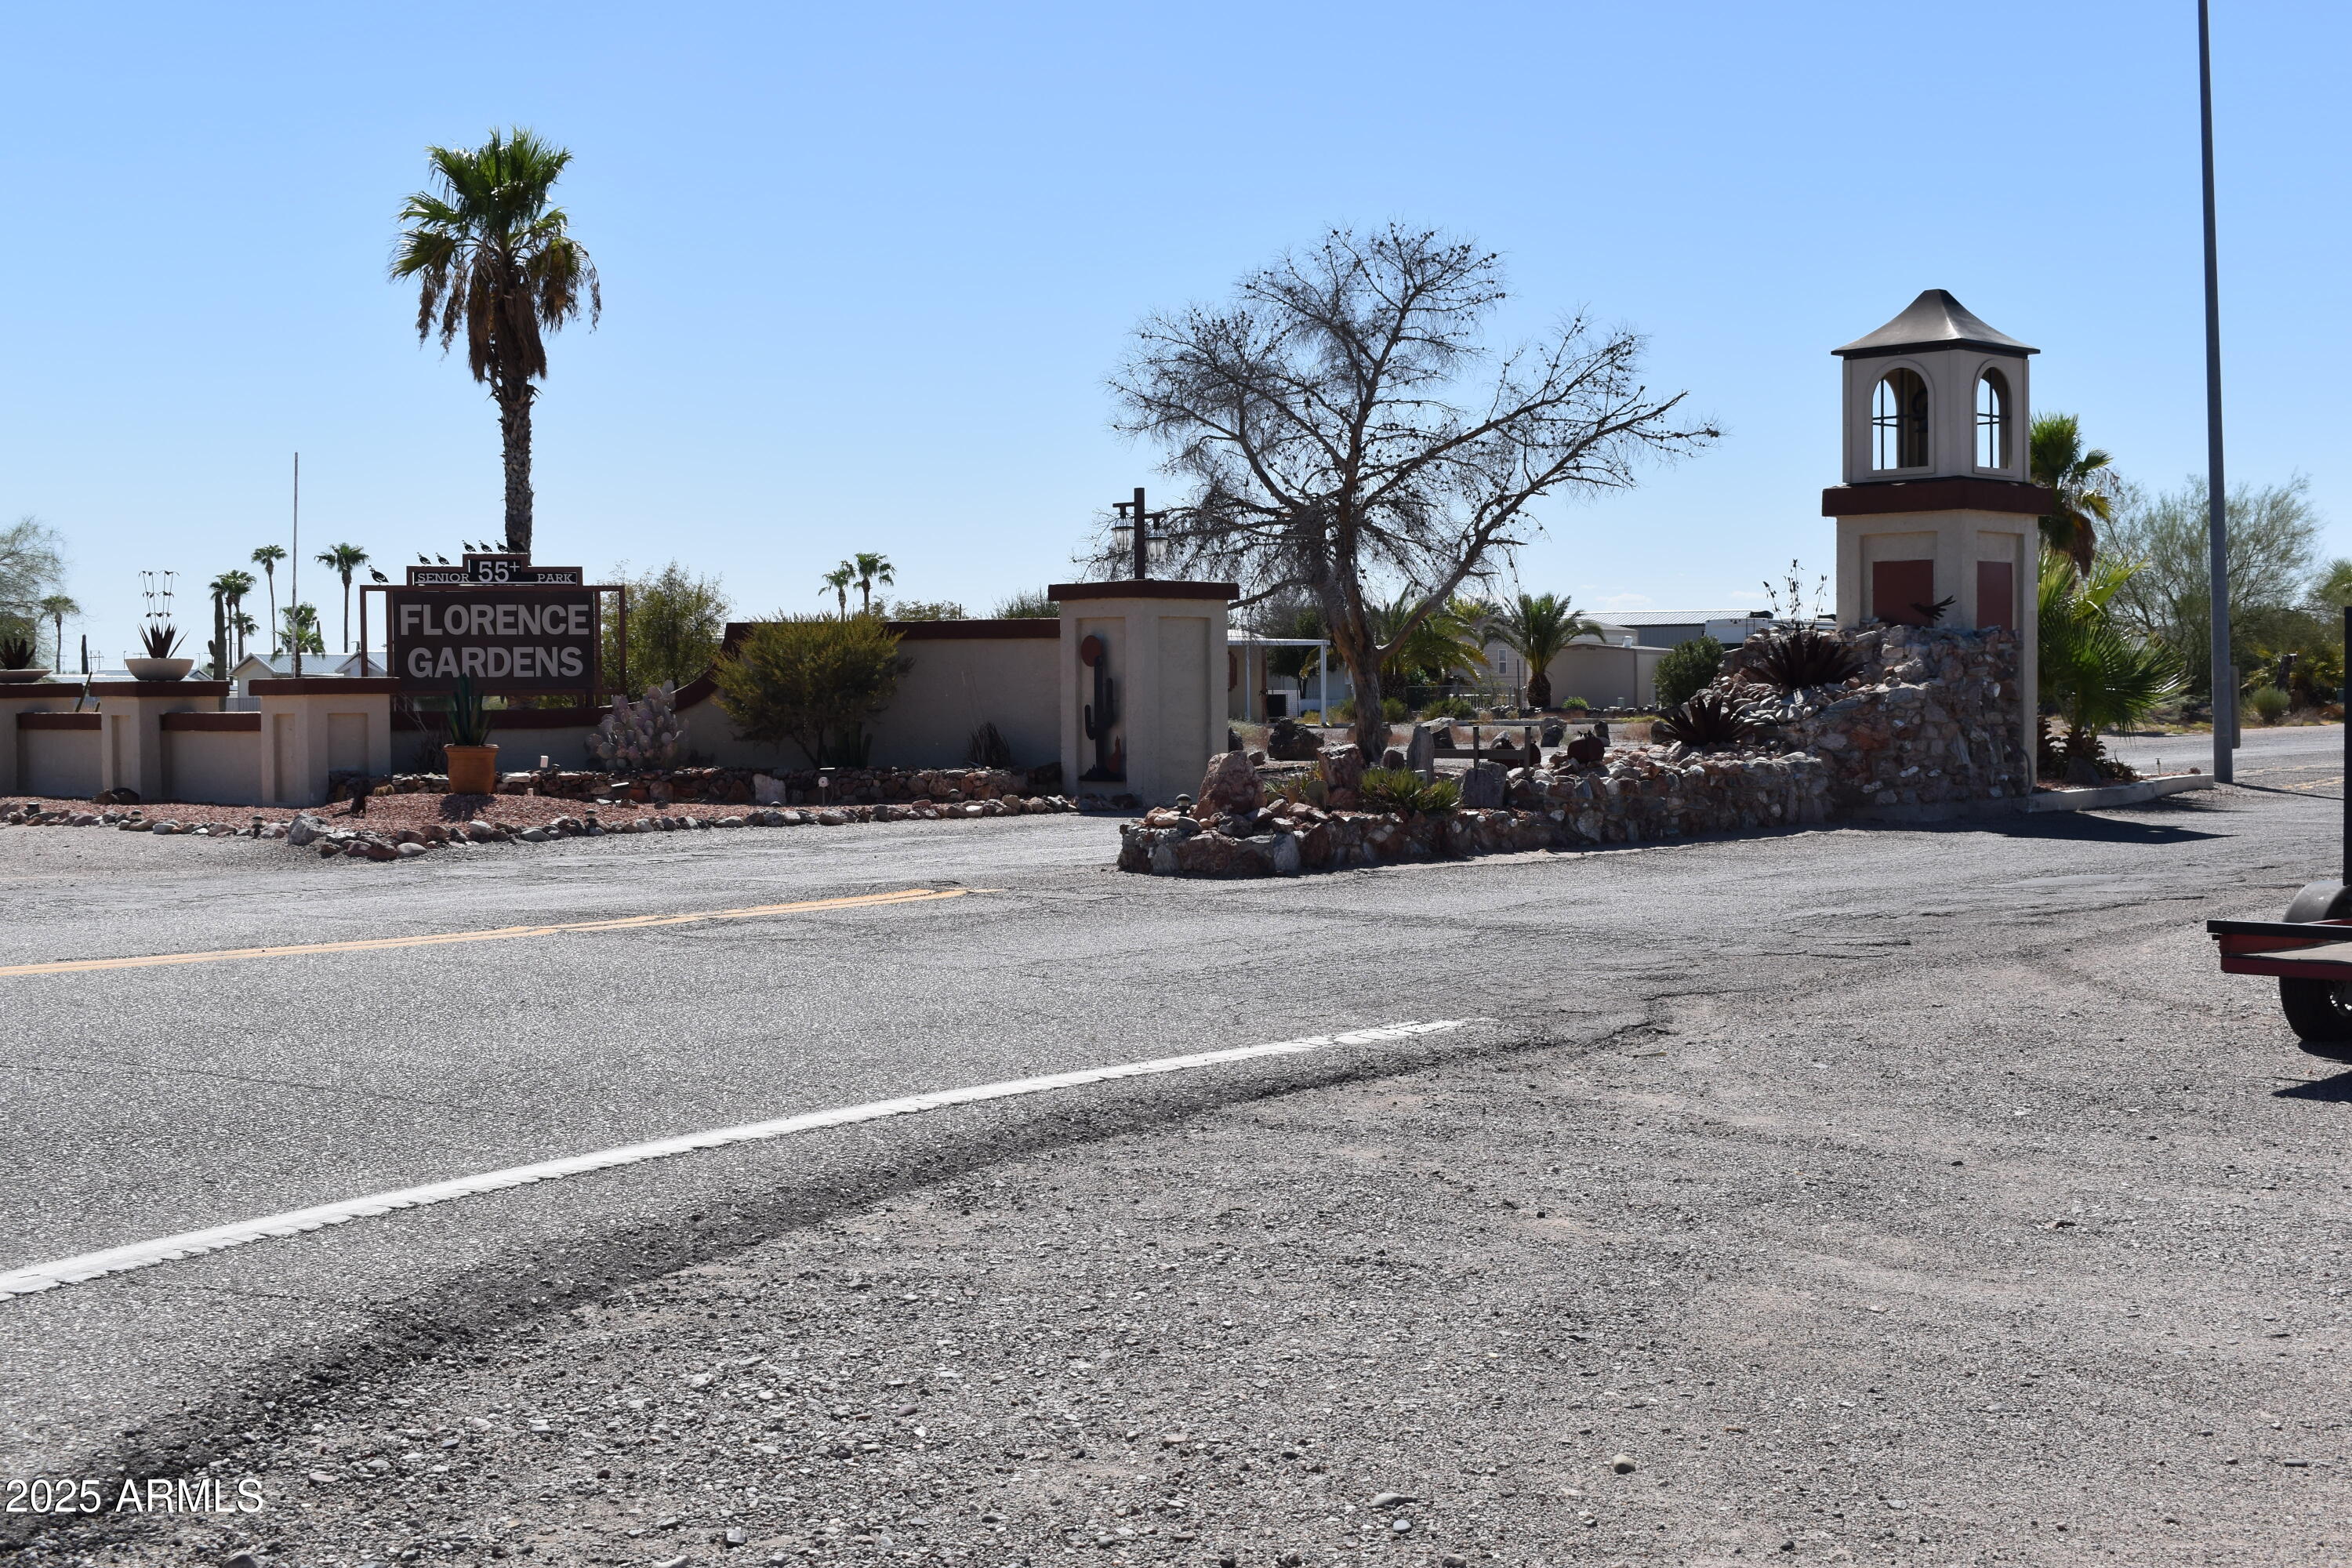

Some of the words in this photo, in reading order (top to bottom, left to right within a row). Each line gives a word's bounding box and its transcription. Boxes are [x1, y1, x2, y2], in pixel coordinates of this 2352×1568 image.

[417, 572, 470, 583] SENIOR
[478, 561, 521, 583] 55+
[537, 573, 573, 583] PARK
[400, 604, 590, 636] FLORENCE
[407, 647, 583, 678] GARDENS
